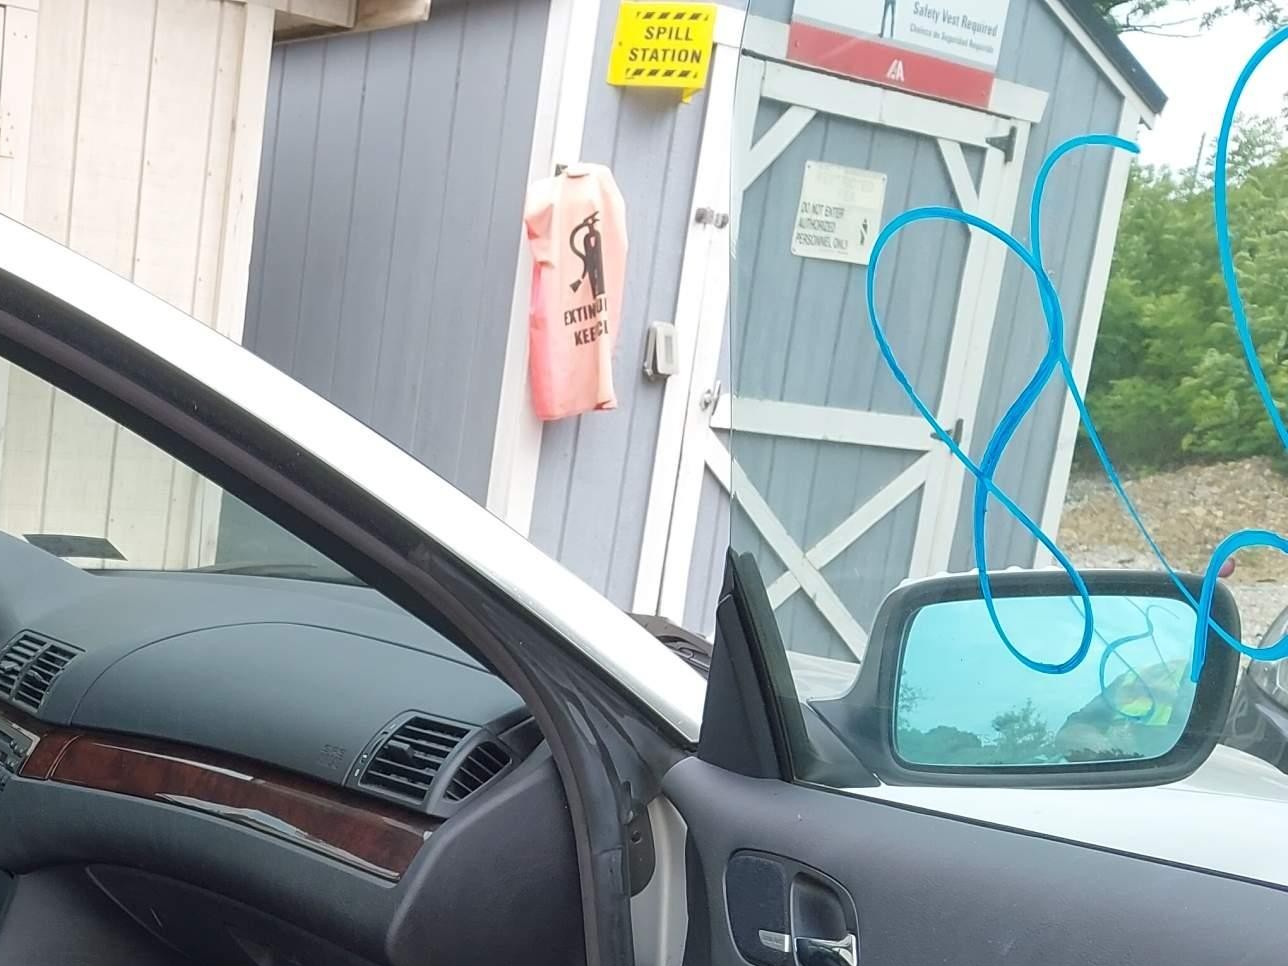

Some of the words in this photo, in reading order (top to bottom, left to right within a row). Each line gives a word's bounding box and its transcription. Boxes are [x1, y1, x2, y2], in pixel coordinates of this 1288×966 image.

[913, 1, 941, 24] Safety
[942, 8, 960, 28] Vest
[961, 15, 999, 37] Required
[644, 26, 693, 41] SPILL
[628, 48, 702, 63] STATION
